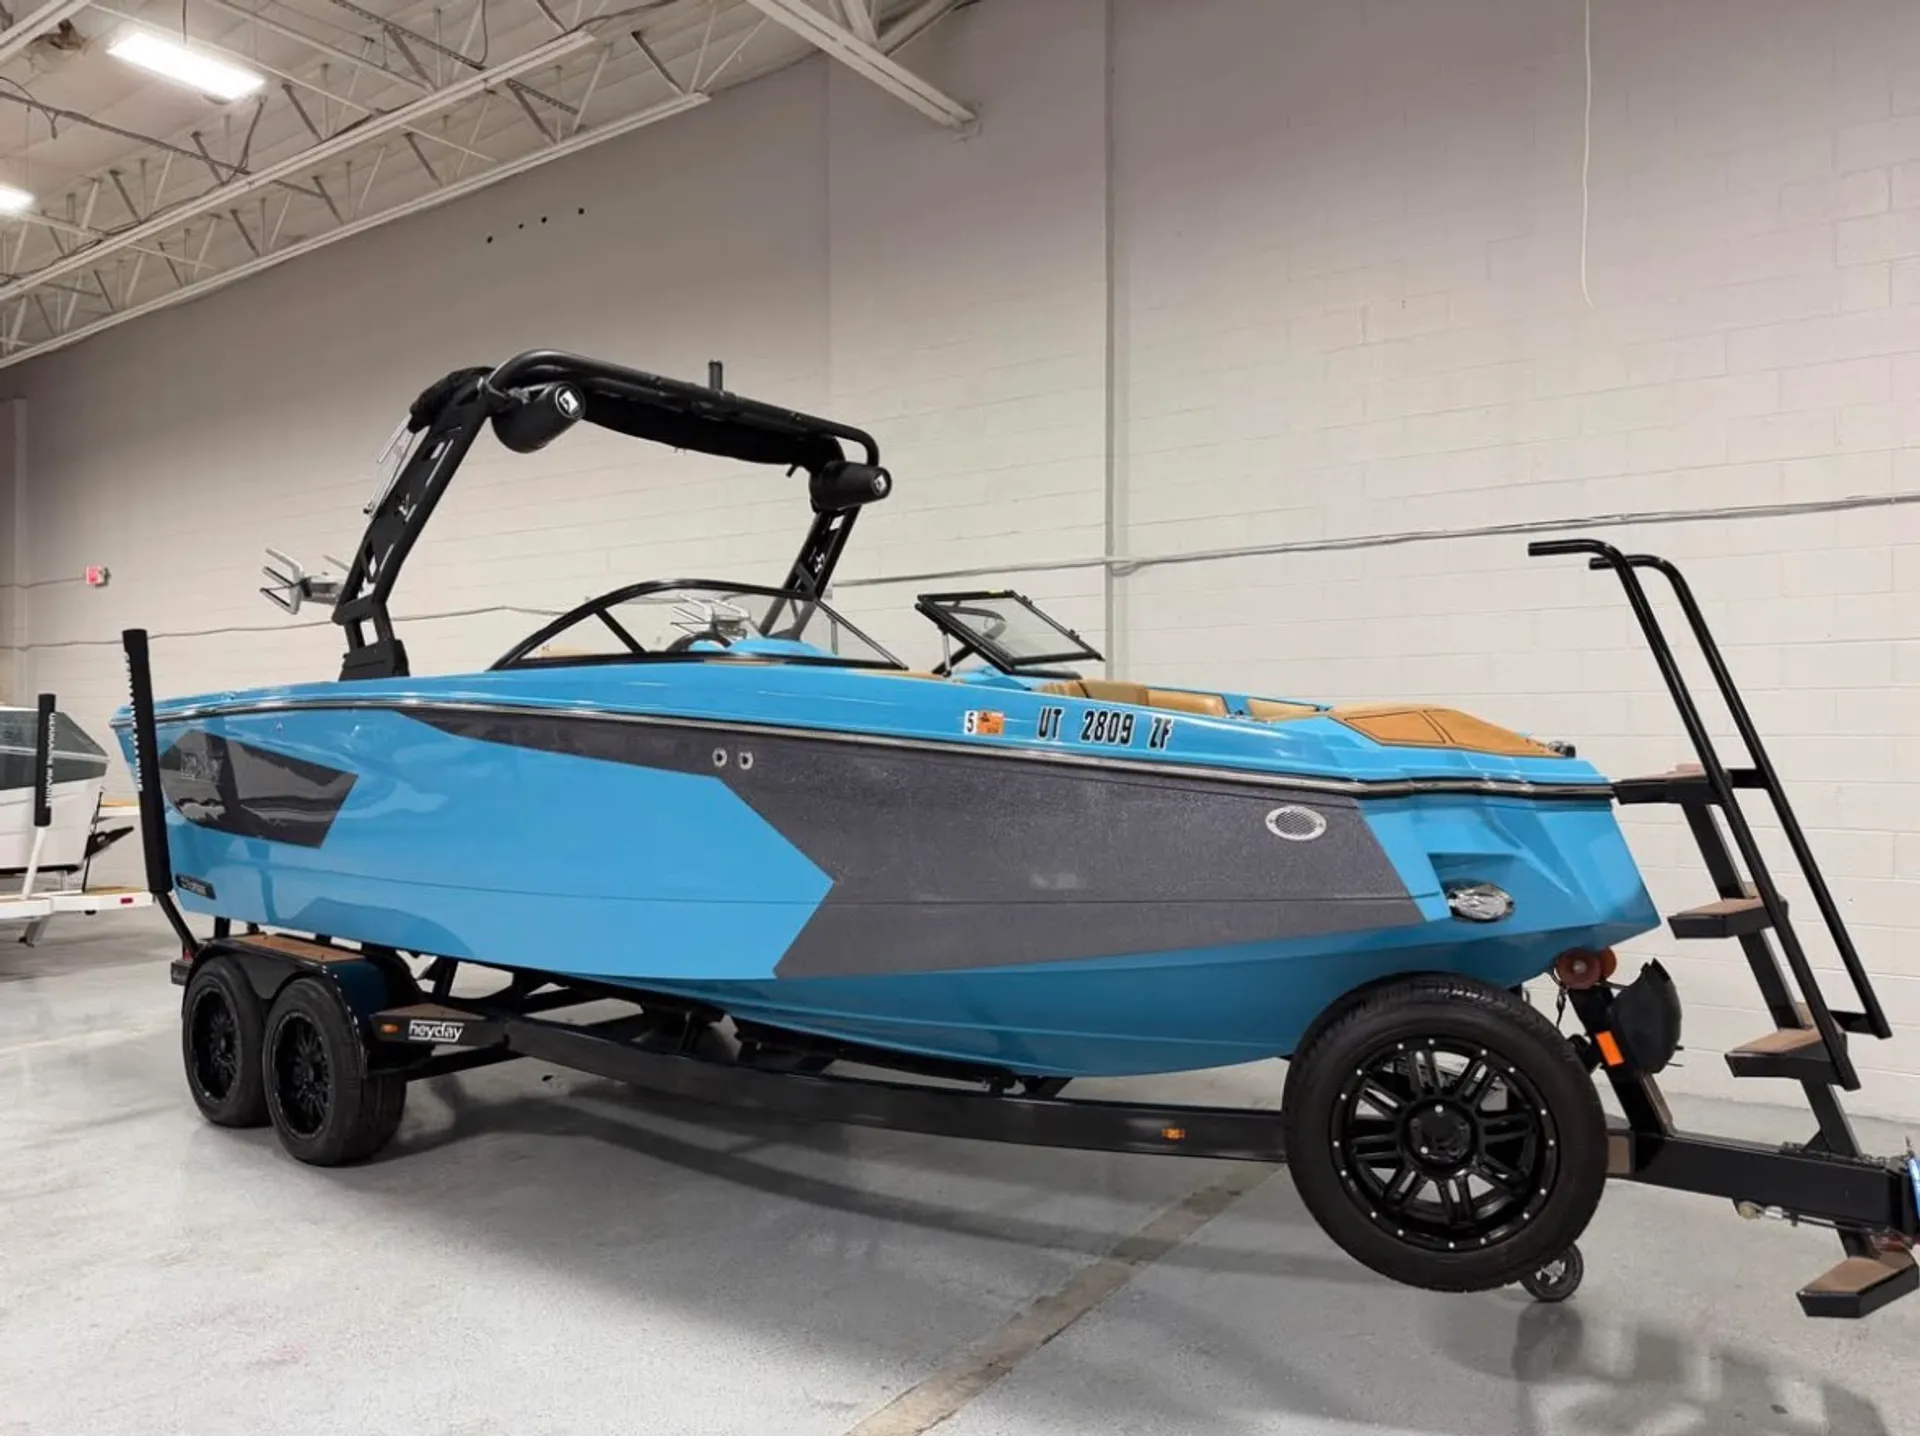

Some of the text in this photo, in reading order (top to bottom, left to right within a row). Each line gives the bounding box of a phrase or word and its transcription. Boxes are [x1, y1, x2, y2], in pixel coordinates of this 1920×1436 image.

[966, 711, 975, 733] 5
[1037, 707, 1173, 751] UT 2809 ZF
[409, 1019, 464, 1043] heyday
